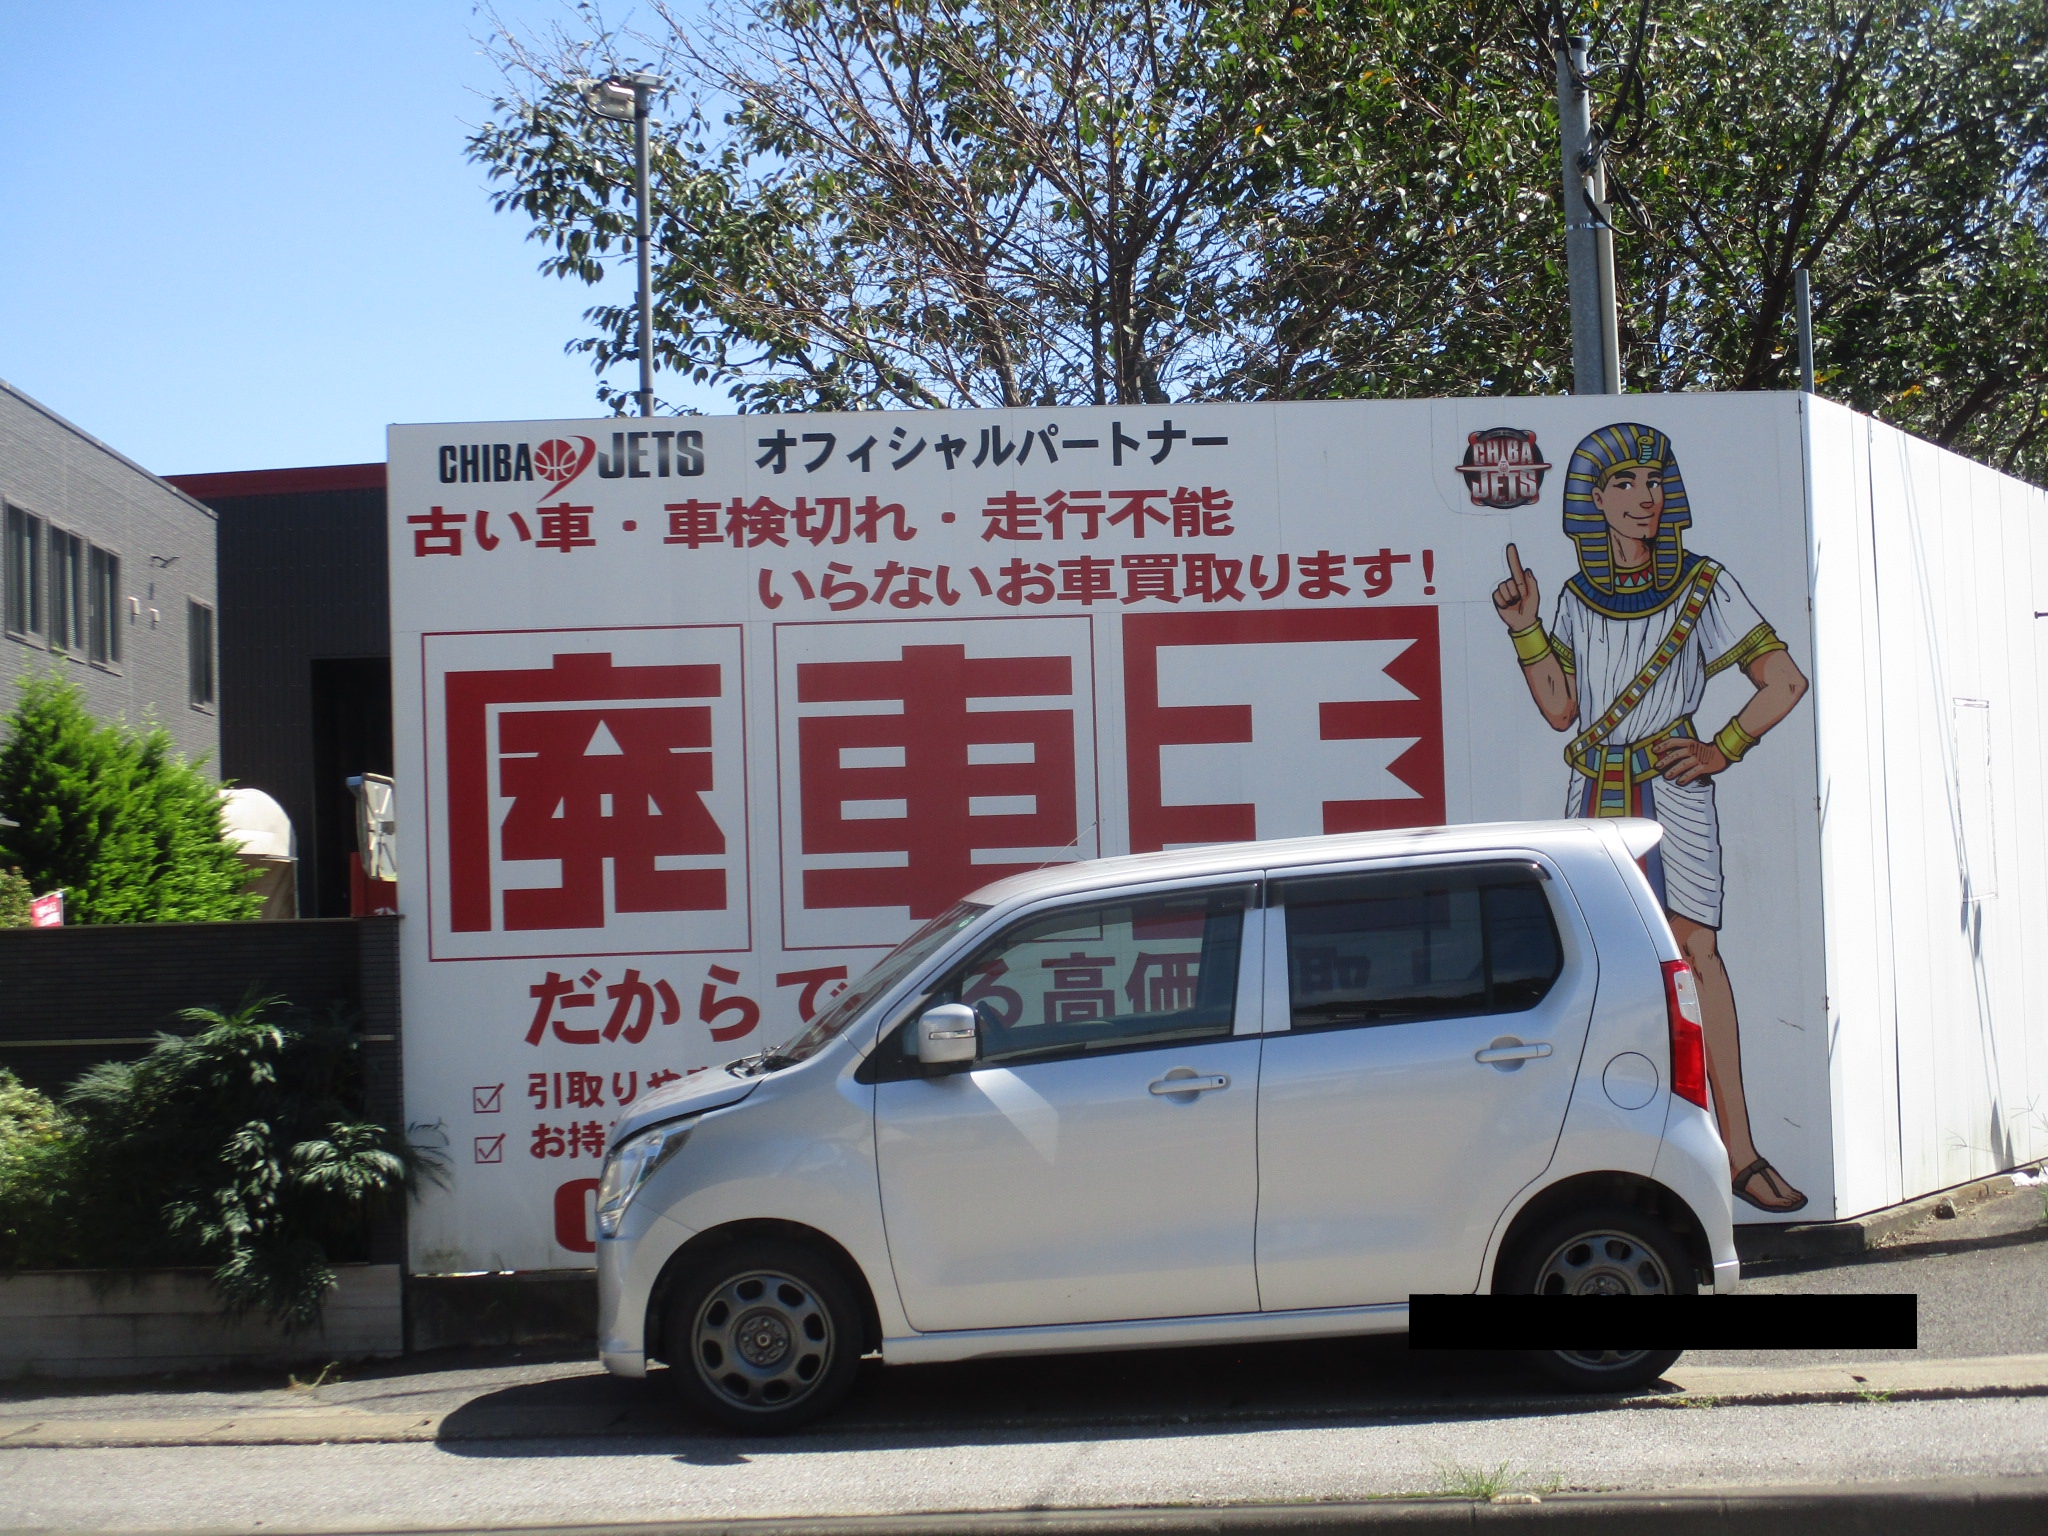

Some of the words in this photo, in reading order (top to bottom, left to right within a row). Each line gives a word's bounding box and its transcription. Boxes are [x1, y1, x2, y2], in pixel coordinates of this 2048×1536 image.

[438, 443, 534, 484] CHIBA
[598, 430, 705, 479] JETS
[755, 419, 1230, 475] オフィシャルパートナー
[1472, 439, 1534, 466] CHIBA
[1472, 470, 1538, 501] JETS
[758, 548, 1438, 612] いらないお車買取ります!
